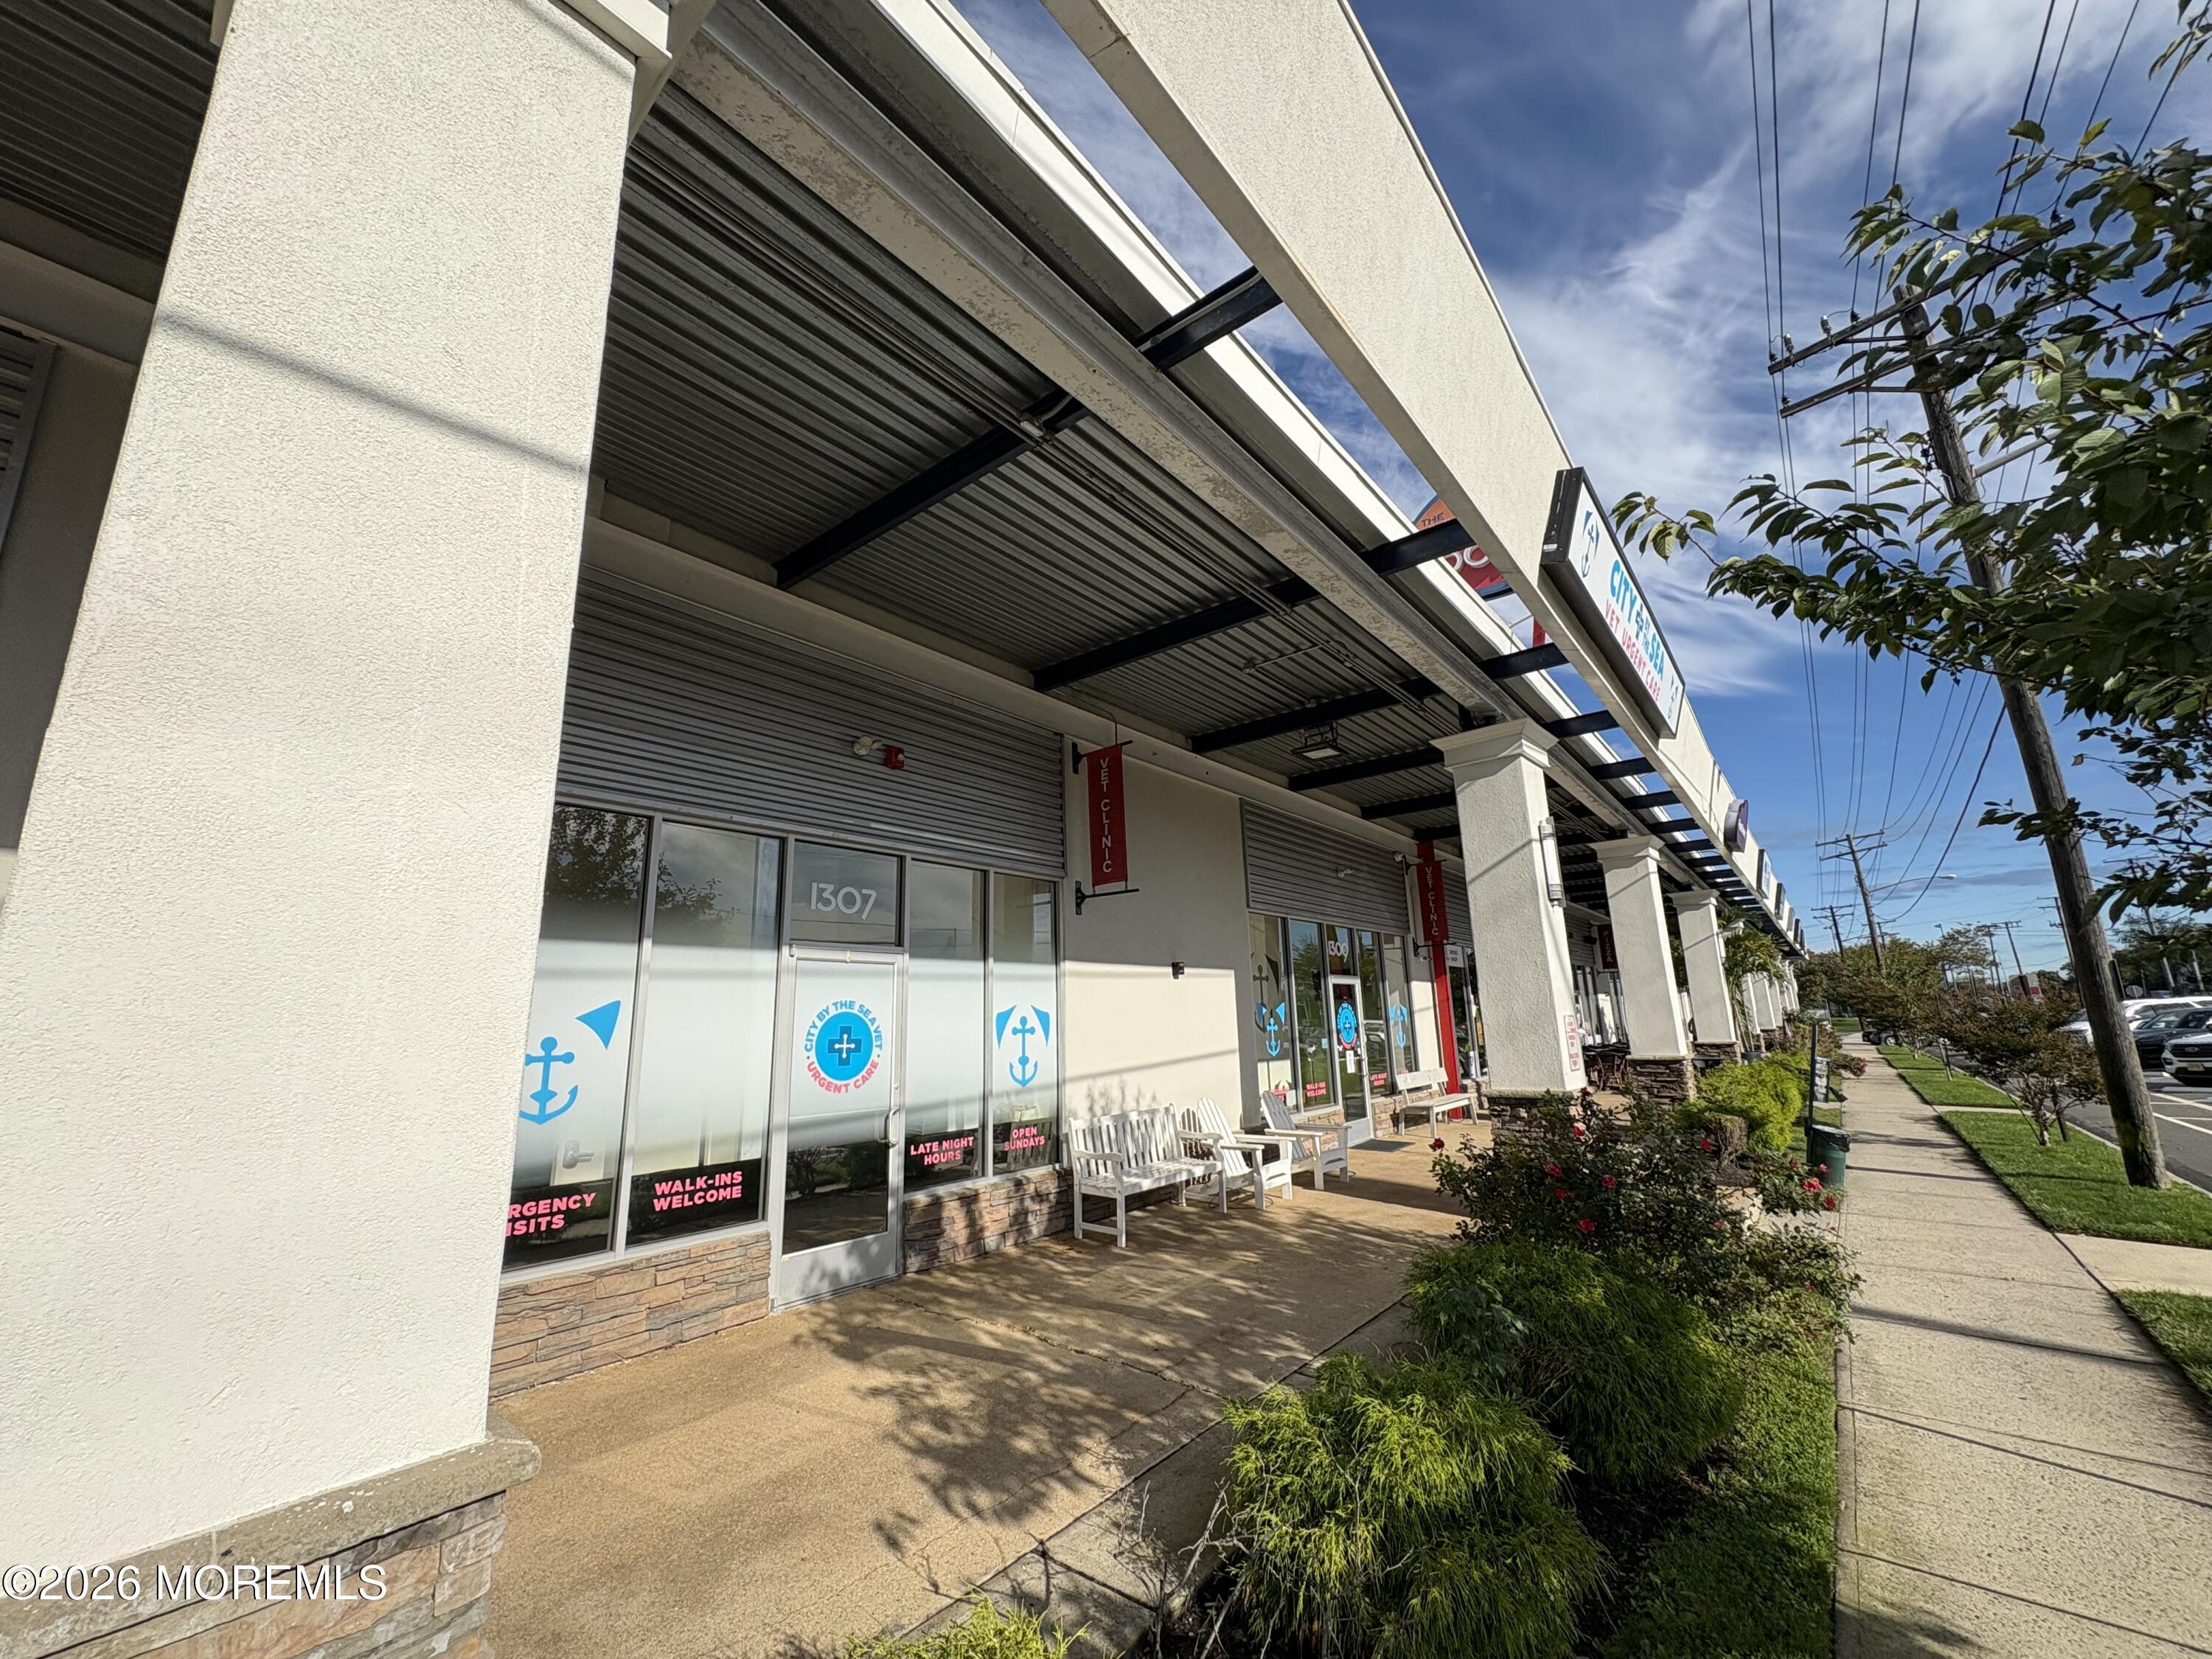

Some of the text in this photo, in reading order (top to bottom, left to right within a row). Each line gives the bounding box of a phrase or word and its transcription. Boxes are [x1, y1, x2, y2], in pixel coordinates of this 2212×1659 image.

[1421, 512, 1445, 526] THE
[1610, 560, 1638, 624] CITY
[1649, 633, 1664, 681] SEA
[1605, 599, 1661, 702] VET URGENT CARE
[1100, 757, 1113, 873] VET CLINIC
[811, 882, 877, 920] 1307
[1425, 866, 1439, 936] VET CLINIC
[1328, 941, 1349, 963] 1309
[1603, 931, 1613, 962] PIZZA
[804, 1000, 883, 1052] CITY BY THE SEA VET
[807, 1059, 879, 1093] URGENT CARE
[910, 1136, 974, 1155] LATE NIGHT
[1004, 1135, 1045, 1151] SUNDAYS
[1012, 1127, 1037, 1138] OPEN
[924, 1150, 961, 1166] HOURS
[654, 1171, 742, 1196] WALK-INS
[508, 1192, 597, 1220] RGENCY
[653, 1185, 742, 1211] WELCOME
[505, 1214, 565, 1237] ISITS
